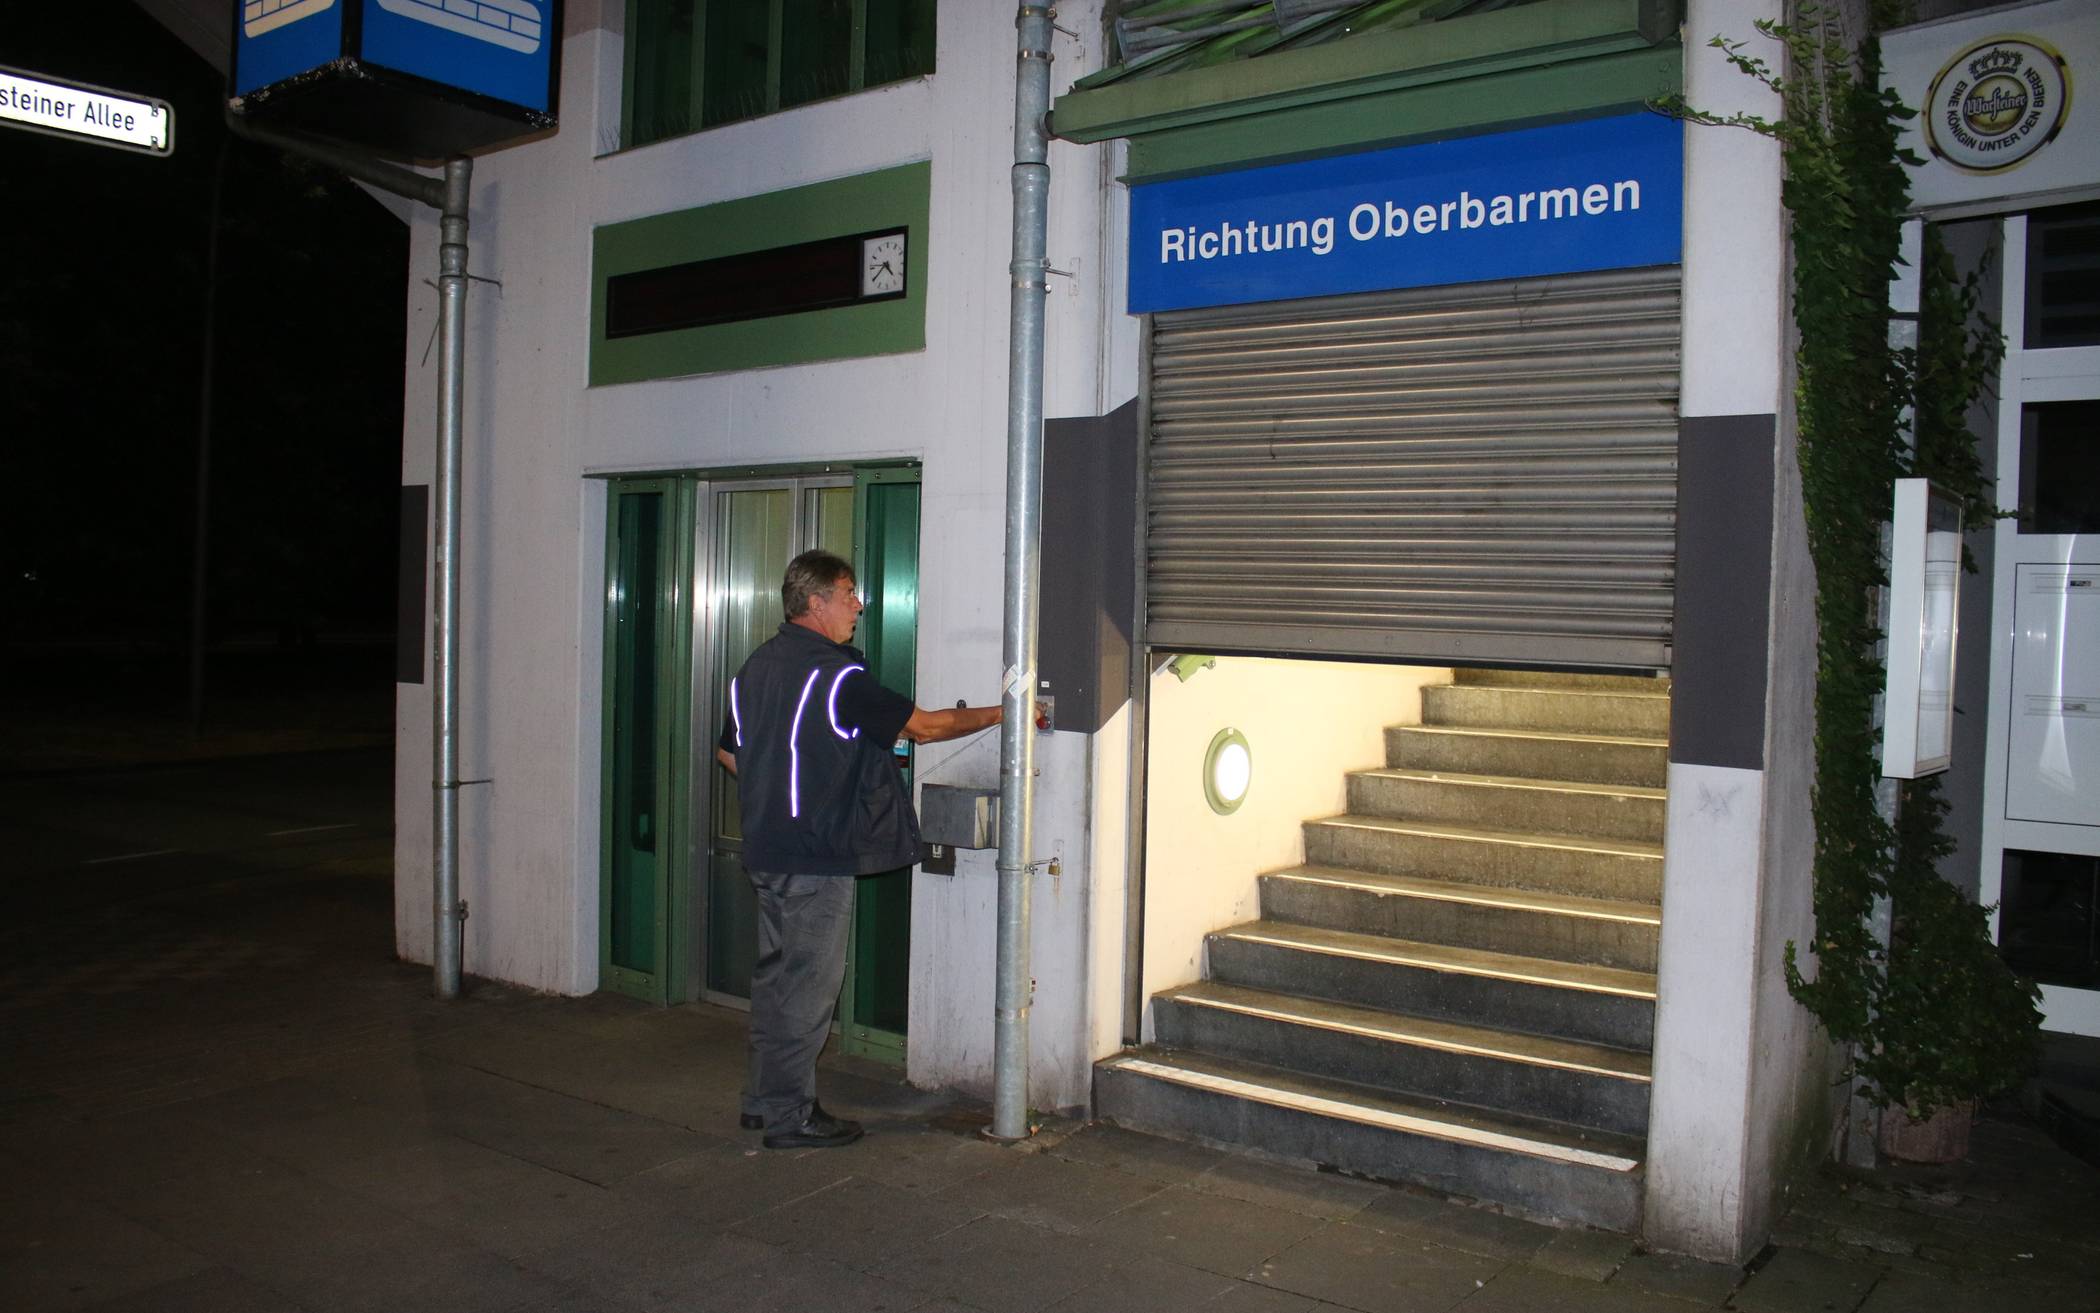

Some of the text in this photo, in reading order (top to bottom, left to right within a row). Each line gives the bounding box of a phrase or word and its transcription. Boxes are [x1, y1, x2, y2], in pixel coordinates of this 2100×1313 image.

[84, 101, 135, 131] Allee
[1947, 67, 2045, 152] EINE KÖNIGIN UNTER DEN BIEREN
[1967, 86, 2028, 122] Warsteiner
[1160, 179, 1640, 264] Richtung Oberbarmen
